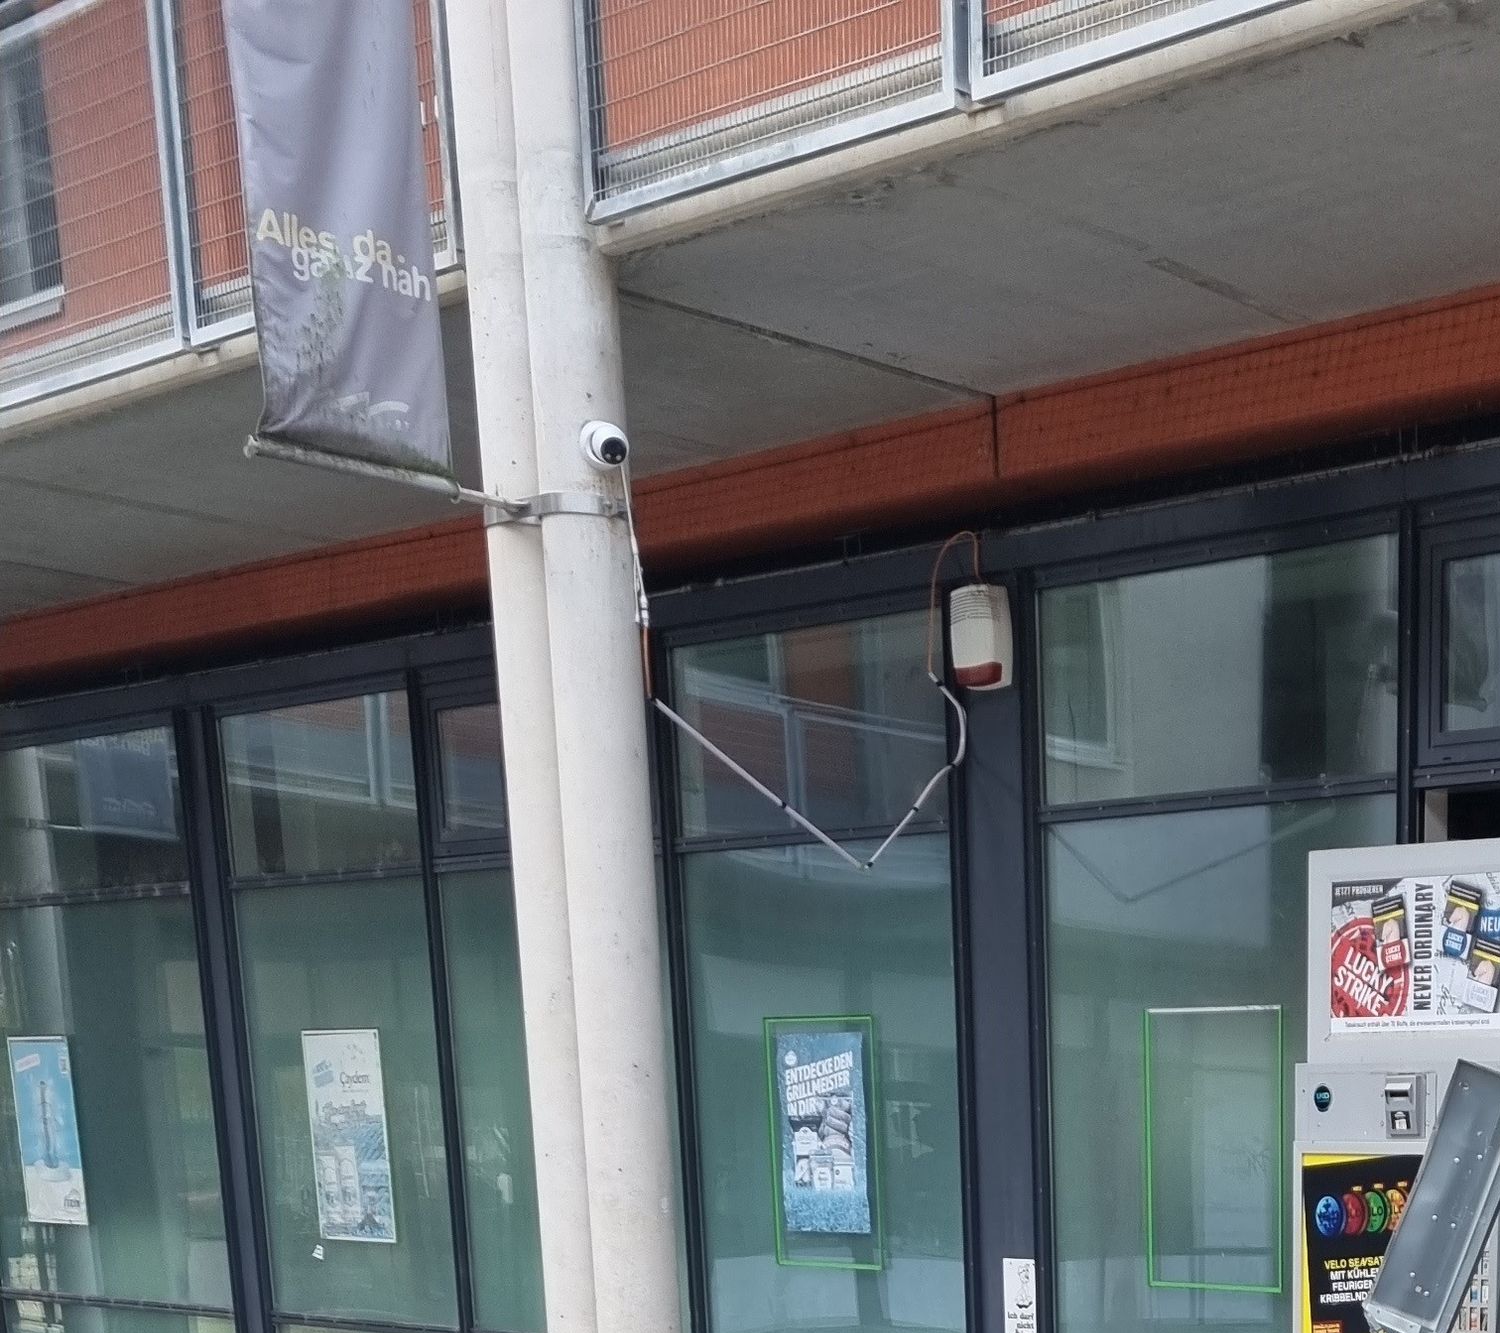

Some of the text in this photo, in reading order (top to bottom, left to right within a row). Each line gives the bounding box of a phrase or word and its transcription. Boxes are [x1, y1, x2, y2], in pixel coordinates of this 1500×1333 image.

[256, 208, 337, 250] Alles
[381, 261, 431, 302] nah
[1385, 944, 1401, 955] LUCKY
[1413, 882, 1433, 1011] NEVER ORDINARY
[1343, 946, 1394, 995] LUCKY
[1334, 965, 1390, 1016] STRIKE
[339, 1070, 370, 1088] Çaydem
[785, 1051, 853, 1086] ENTDECKE DEN
[786, 1070, 850, 1102] GRILLMEISTER
[787, 1097, 818, 1116] IN DIR
[1324, 1259, 1347, 1270] VELO
[1330, 1267, 1379, 1281] MIT KÜHLE
[1320, 1291, 1369, 1304] KRIBBELND
